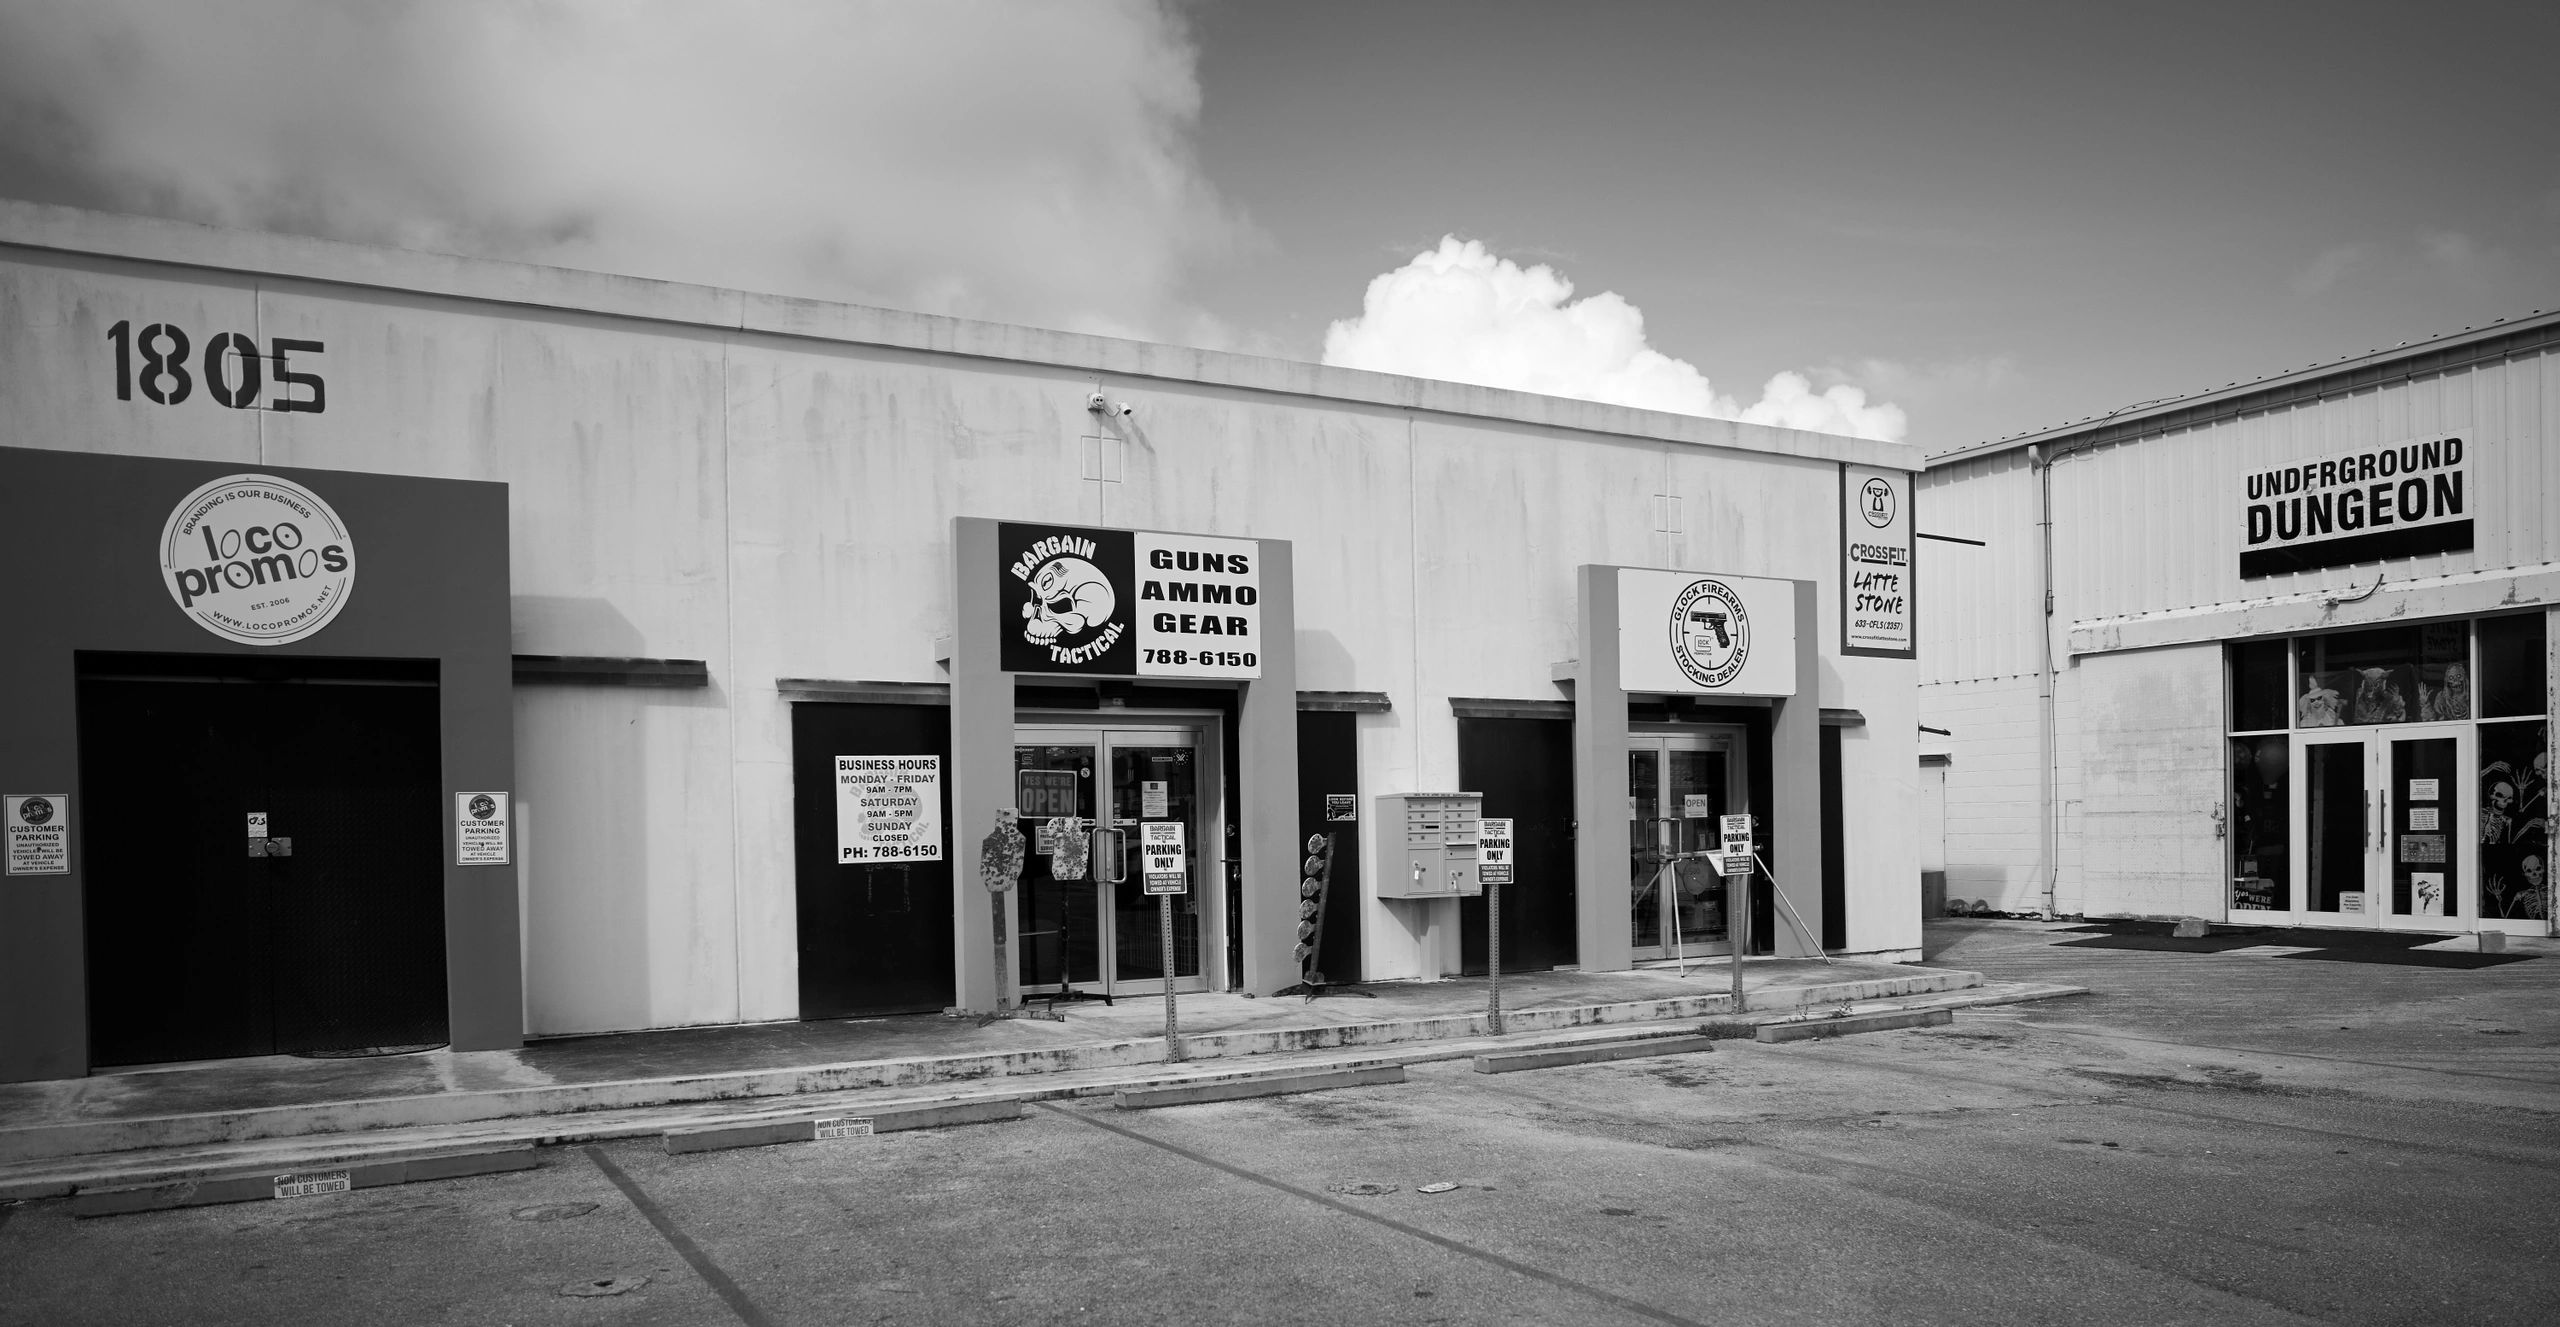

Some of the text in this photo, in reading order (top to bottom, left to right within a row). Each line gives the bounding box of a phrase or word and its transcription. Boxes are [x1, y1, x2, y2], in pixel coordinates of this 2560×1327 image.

[107, 320, 325, 414] 1805
[183, 490, 312, 536] BRANDING IS OUR BUSINESS
[2247, 469, 2463, 546] DUNGEON
[202, 522, 303, 562] loco
[1011, 535, 1096, 581] BARGAIN
[1150, 549, 1249, 574] GUNS
[175, 545, 348, 608] promos
[1853, 570, 1898, 592] LATTE
[1141, 580, 1257, 605] AMMO
[213, 584, 332, 631] WWW.LOCOPROMOS.NET
[251, 597, 290, 611] EST. 2006
[1675, 584, 1744, 623] GLOCK FIREARMS
[1855, 593, 1904, 615] STONE
[1153, 612, 1248, 636] GEAR
[1051, 620, 1125, 664] TACTICAL
[1143, 649, 1257, 667] 788-6150
[1676, 645, 1744, 683] STOCKING DEALER
[839, 760, 937, 770] BUSINESS HOURS
[841, 775, 887, 783] MONDAY
[897, 774, 935, 783] FRIDAY
[1024, 776, 1072, 786] YES WE'RE
[860, 798, 918, 807] SATURDAY
[1022, 788, 1073, 813] OPEN
[1686, 799, 1706, 807] OPEN
[10, 825, 65, 833] CUSTOMER
[868, 822, 912, 831] SUNDAY
[872, 834, 909, 842] CLOSED
[1480, 838, 1510, 848] PARKING
[1723, 832, 1750, 843] PARKING
[843, 845, 937, 859] PH: 788-6150
[1146, 844, 1181, 855] PARKING
[1486, 850, 1503, 860] ONLY
[1729, 844, 1744, 853] ONLY
[1154, 857, 1174, 868] ONLY
[817, 1118, 871, 1128] NON CUSTOMERS
[819, 1125, 869, 1138] WILL BE TOWED
[277, 1169, 348, 1186] NON CUSTOMERS
[281, 1181, 345, 1197] WILL BE TOWED
